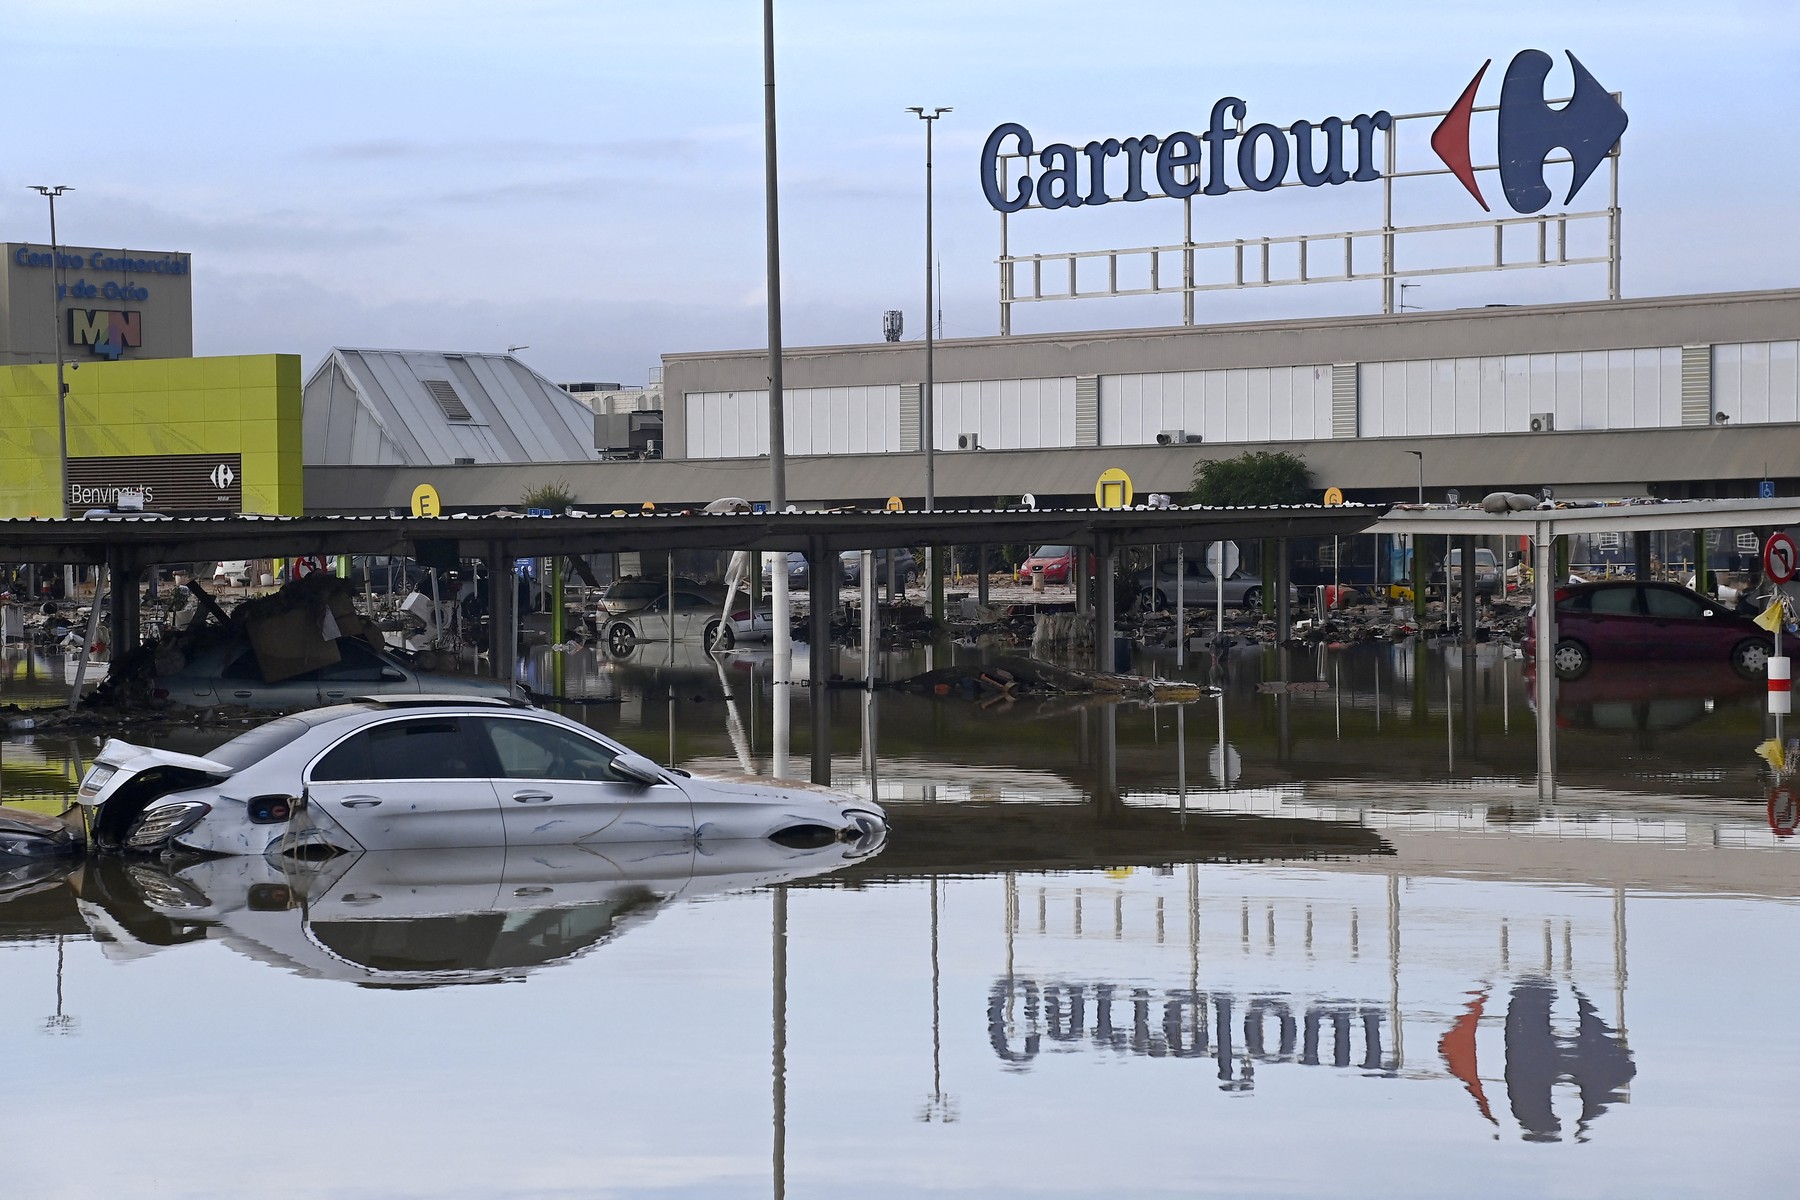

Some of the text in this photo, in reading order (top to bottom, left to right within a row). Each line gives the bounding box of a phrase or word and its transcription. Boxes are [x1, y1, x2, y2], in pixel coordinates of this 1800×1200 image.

[980, 96, 1391, 213] Carrefour
[15, 247, 189, 275] Centro Comercial
[72, 278, 98, 298] de
[104, 281, 149, 301] Ocio
[71, 484, 153, 504] Benvints
[419, 495, 432, 516] E
